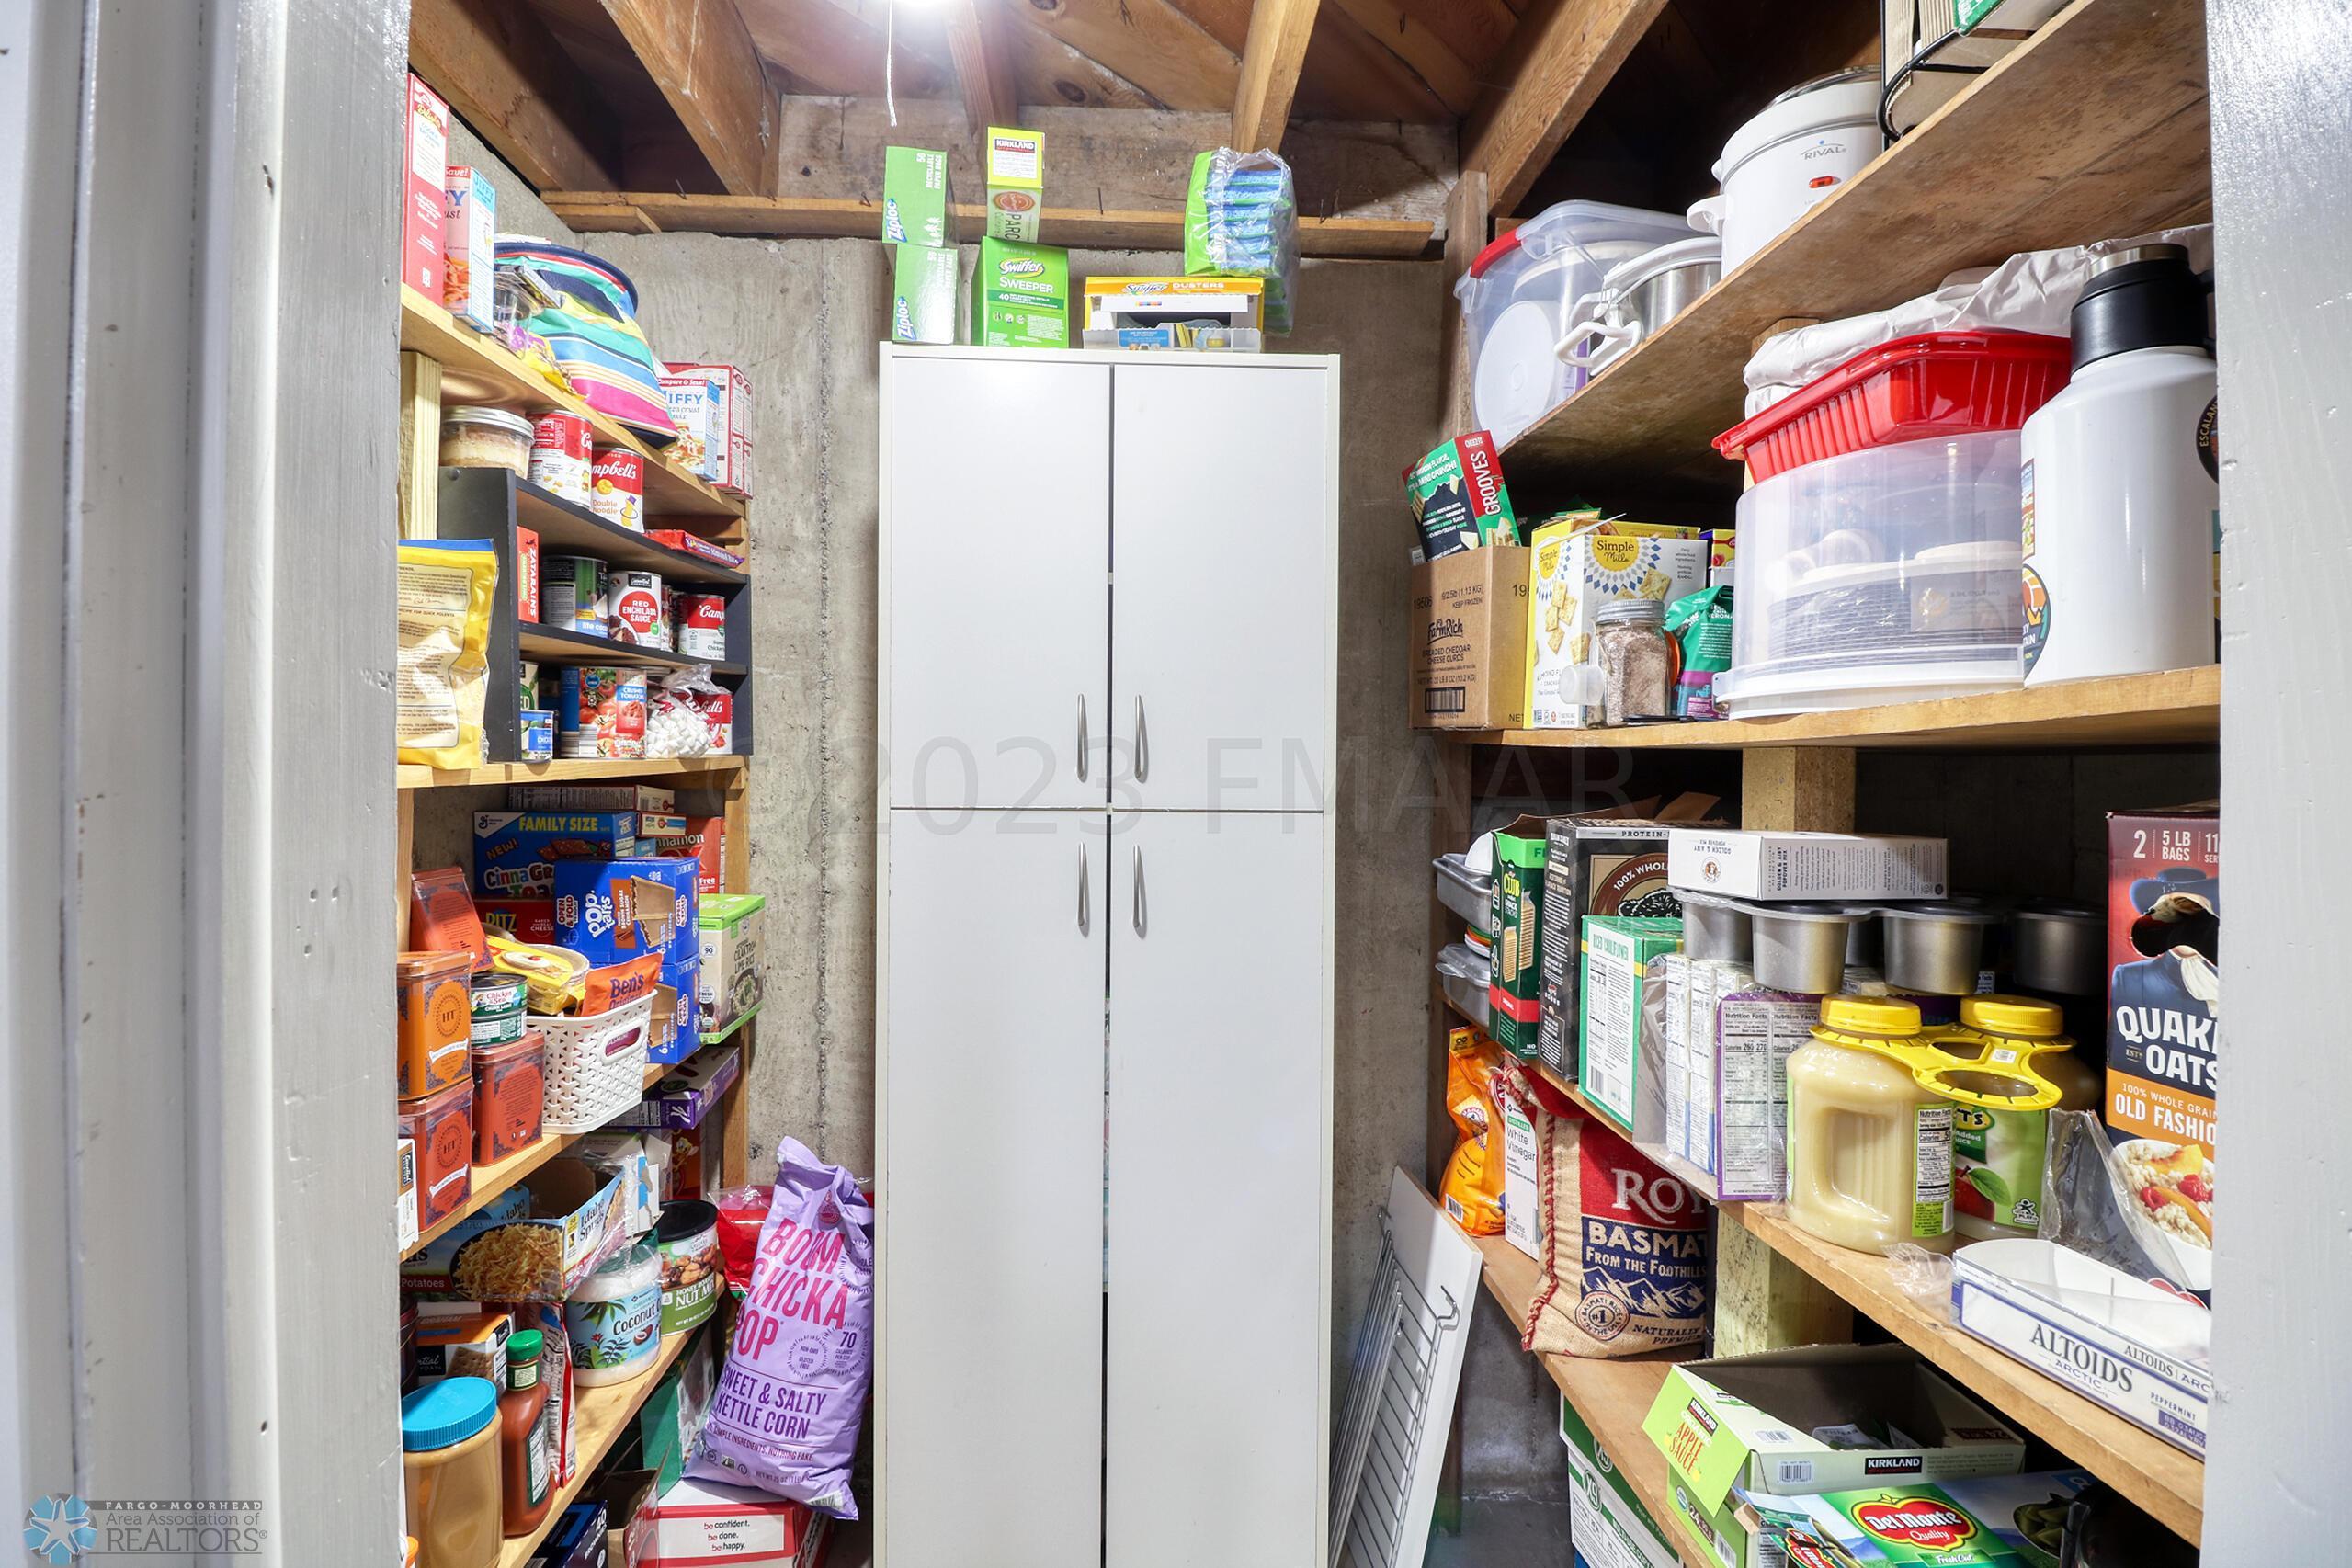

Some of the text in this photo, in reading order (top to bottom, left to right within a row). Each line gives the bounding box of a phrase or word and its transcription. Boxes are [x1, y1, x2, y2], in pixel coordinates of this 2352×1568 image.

[996, 139, 1034, 150] KIRKLAND
[1803, 143, 1843, 160] RIVAL
[887, 199, 903, 242] Ziploc
[1000, 260, 1043, 275] Swiffer
[999, 277, 1054, 293] SWEEPER
[897, 300, 915, 339] Ziploc
[1471, 450, 1502, 516] GROOVES
[1597, 540, 1634, 555] Simple
[1604, 552, 1630, 562] Mills
[1512, 585, 1528, 597] 19
[631, 614, 651, 623] SAUCE
[519, 816, 597, 832] FAMILY SIZE
[2133, 830, 2191, 858] 2 5 LB
[2162, 846, 2191, 862] BAGS
[1613, 869, 1636, 892] 100%
[486, 990, 512, 1000] Chicken
[609, 971, 643, 999] Ben's
[2145, 1043, 2219, 1092] OATS
[2115, 1093, 2146, 1122] OLD
[2122, 1083, 2148, 1098] 100%
[2151, 1090, 2184, 1110] WHOLE
[1508, 1117, 1530, 1131] DISTILLED
[1919, 1108, 1941, 1119] Nutrition
[1507, 1125, 1528, 1145] White
[1507, 1138, 1536, 1163] Vinegar
[580, 1198, 604, 1226] Idaho
[1586, 1246, 1707, 1278] FROM THE FOOTHILLS
[401, 1278, 445, 1288] Potatoes
[676, 1290, 699, 1307] NUT
[613, 1305, 656, 1335] Coconut
[839, 1331, 857, 1348] 70
[2028, 1324, 2133, 1393] ALTOIDS
[2124, 1345, 2174, 1377] ALTOIDS
[2055, 1358, 2103, 1389] ARCTIC
[721, 1363, 827, 1415] SWEET & SALTY
[715, 1390, 811, 1439] KETTLE CORN
[1690, 1399, 1718, 1430] KIRKLAND
[2150, 1392, 2197, 1422] PEPPERMINT
[1676, 1422, 1704, 1458] APPLE
[1668, 1436, 1698, 1476] SAUCE
[1868, 1458, 1921, 1469] KIRKLAND
[704, 1519, 750, 1530] be confident.
[1865, 1508, 1963, 1532] Del Monte
[708, 1531, 739, 1541] be done.
[712, 1541, 745, 1552] be happy.
[1909, 1528, 1950, 1542] Quality
